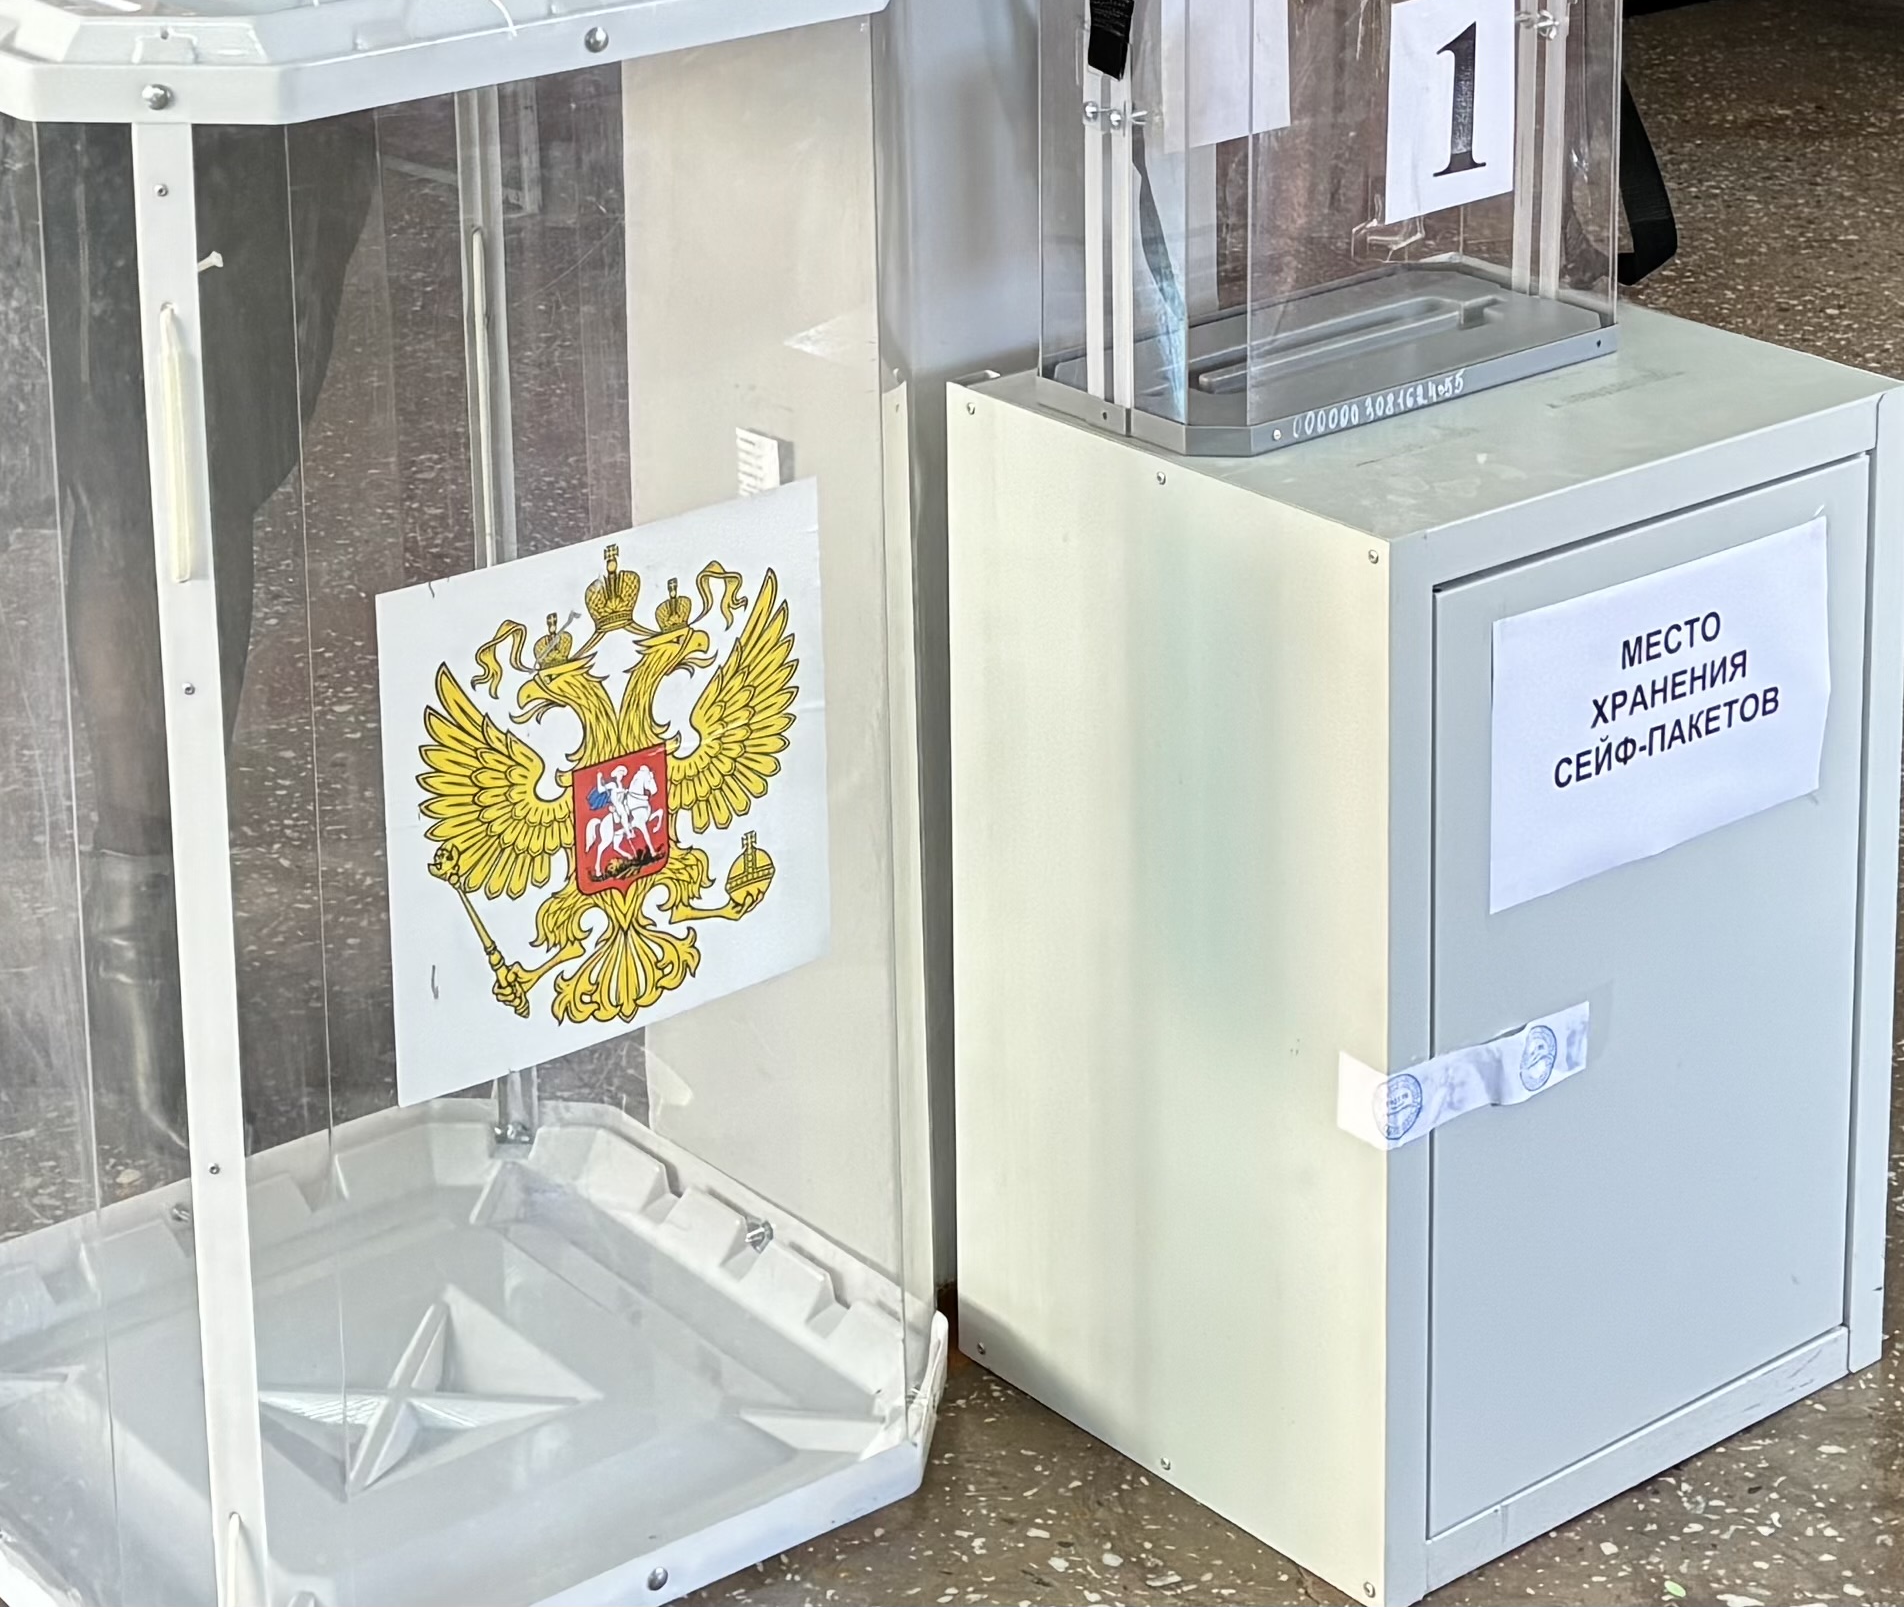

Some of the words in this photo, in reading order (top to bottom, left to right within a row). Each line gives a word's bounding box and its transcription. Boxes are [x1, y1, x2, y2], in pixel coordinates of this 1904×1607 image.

[1432, 20, 1487, 178] 1
[1620, 611, 1722, 670] МЕСТО
[1590, 649, 1748, 729] ХРАНЕНИЯ
[1553, 686, 1780, 789] СЕЙФ-ПАКЕТОВ
